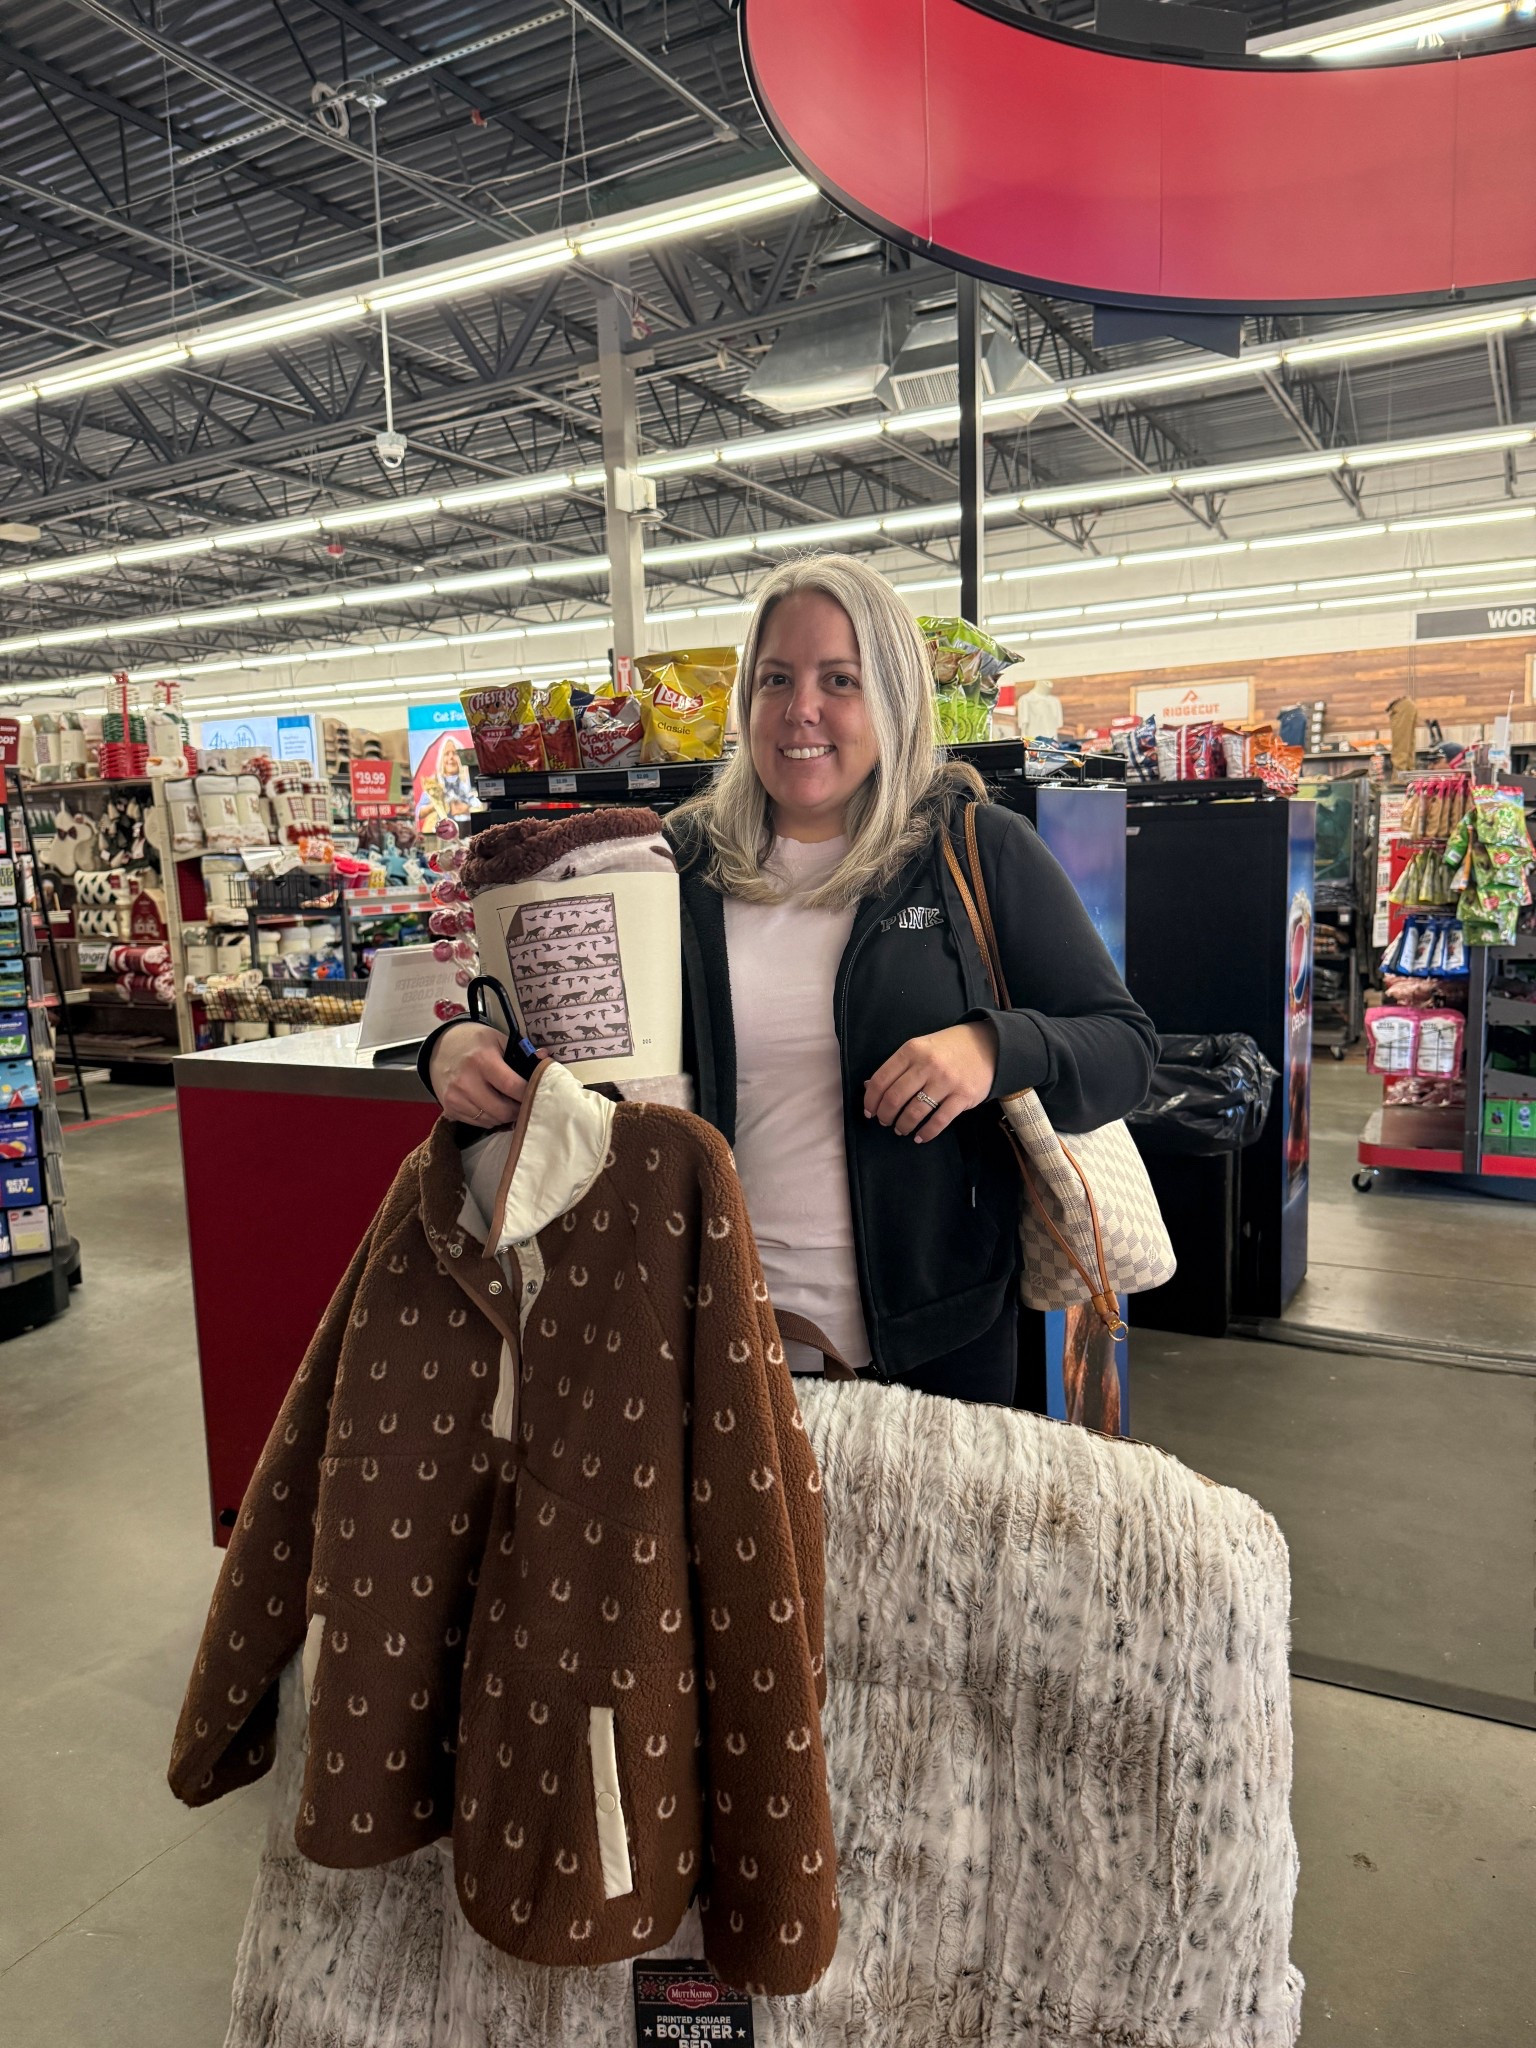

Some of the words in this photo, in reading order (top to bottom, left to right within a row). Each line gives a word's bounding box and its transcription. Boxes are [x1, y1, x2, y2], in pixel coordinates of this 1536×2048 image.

[1487, 607, 1536, 629] WOR
[433, 711, 449, 722] Cat
[450, 710, 466, 721] Foo
[1163, 703, 1220, 717] RIDGECUT
[657, 721, 691, 735] Classic
[580, 730, 626, 745] Cracker
[588, 741, 616, 759] Jack
[880, 906, 945, 933] PINK
[6, 1178, 29, 1187] BEST
[8, 1185, 27, 1194] BUY
[657, 2015, 693, 2025] PRINTED
[695, 2015, 731, 2025] SQUARE
[656, 2024, 733, 2040] BOLSTER
